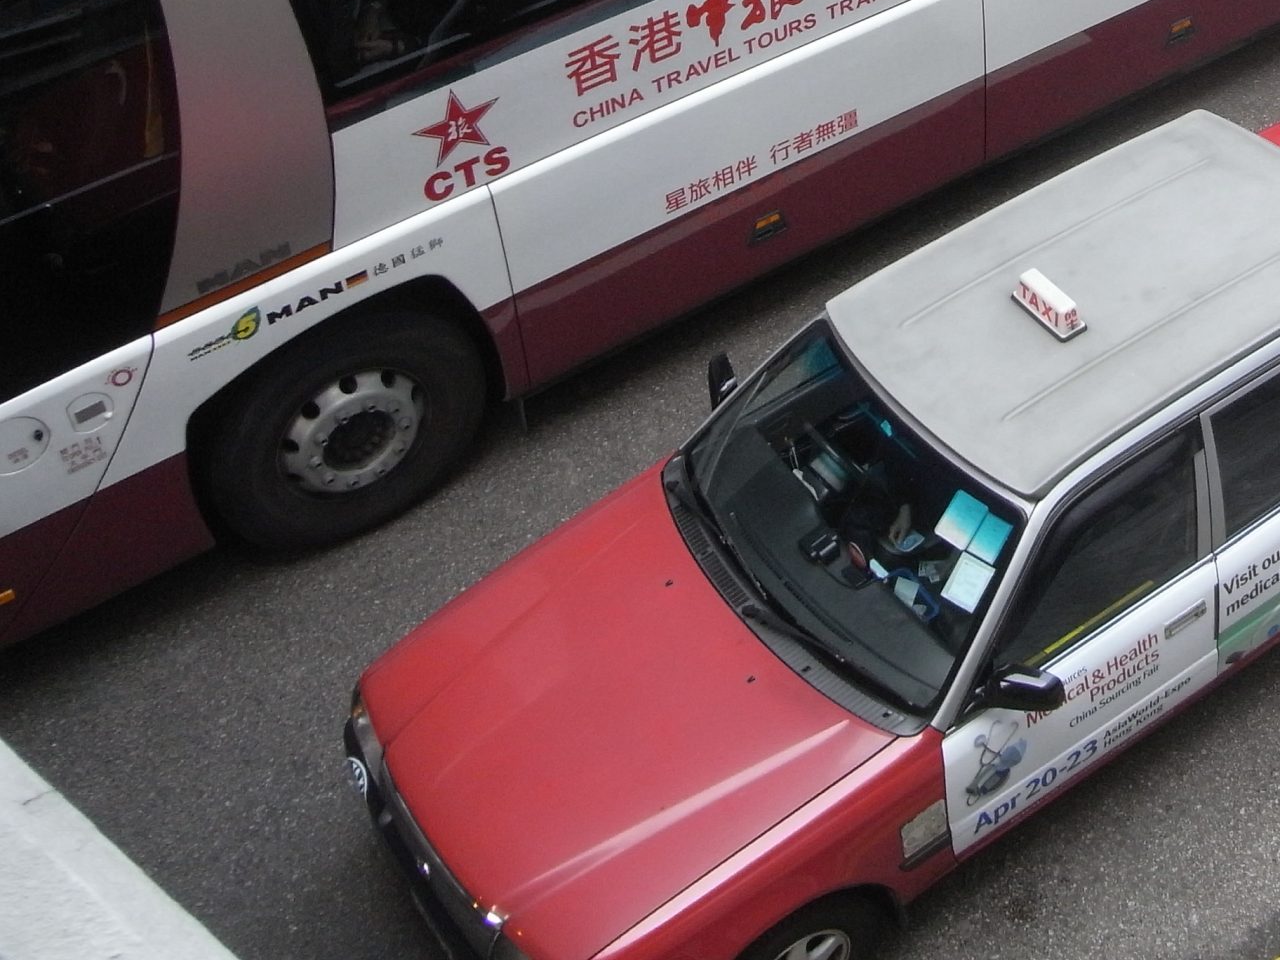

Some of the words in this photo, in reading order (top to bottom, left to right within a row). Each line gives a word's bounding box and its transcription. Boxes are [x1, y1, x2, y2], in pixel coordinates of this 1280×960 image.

[573, 90, 644, 128] CHINA
[652, 46, 741, 93] TRAVEL
[744, 13, 817, 54] TOURS
[423, 146, 511, 201] CTS
[665, 155, 758, 215] 星旅相伴
[266, 281, 345, 325] MAN
[1019, 281, 1059, 328] TAXI
[1223, 562, 1258, 595] Visit
[1090, 650, 1160, 702] Products
[1092, 669, 1106, 686] &
[1106, 632, 1159, 676] Health
[1069, 706, 1098, 728] China
[1099, 677, 1142, 710] Sourcing
[1143, 663, 1161, 682] Fair
[1103, 676, 1191, 739] AsiaWorld-Expo
[1103, 729, 1133, 748] Hong
[1136, 704, 1164, 727] Kong
[974, 790, 1021, 834] Apr
[1026, 739, 1097, 799] 20-23
